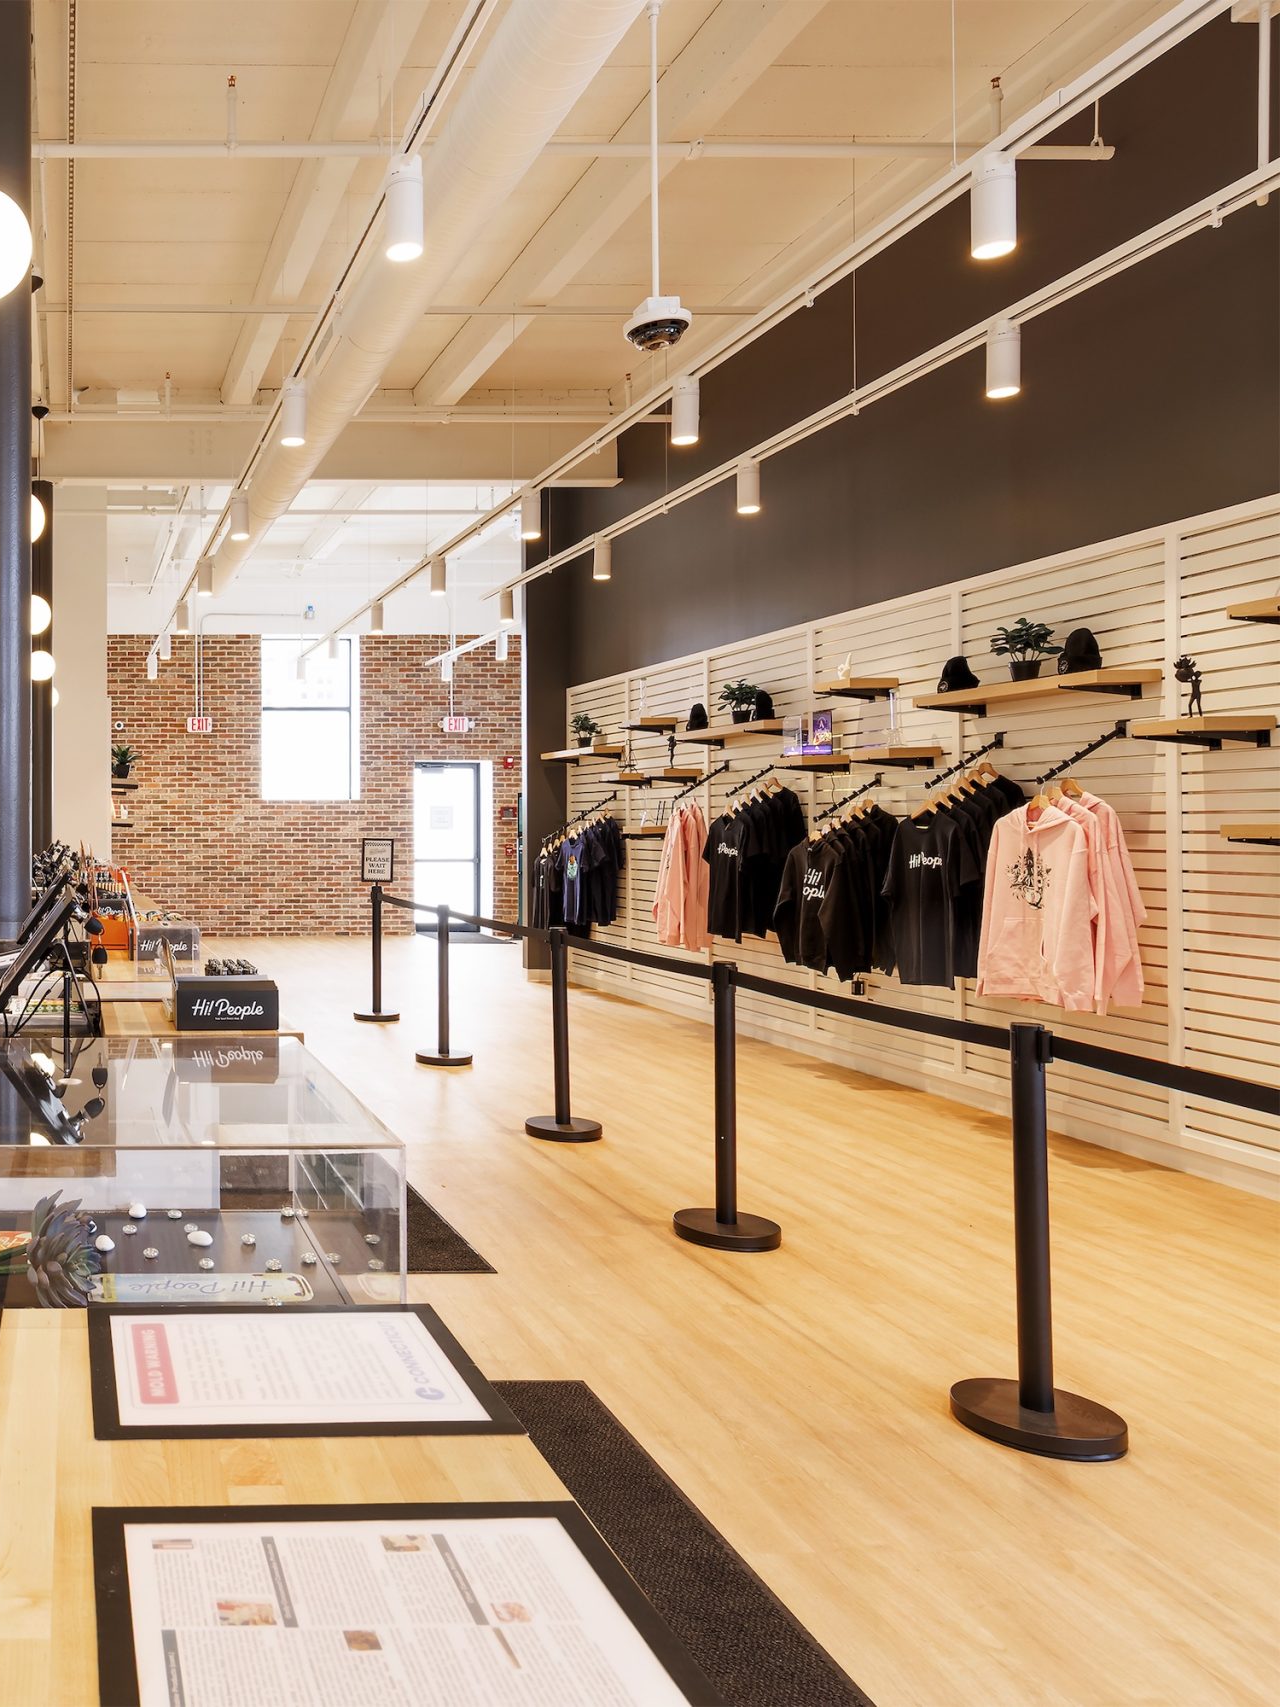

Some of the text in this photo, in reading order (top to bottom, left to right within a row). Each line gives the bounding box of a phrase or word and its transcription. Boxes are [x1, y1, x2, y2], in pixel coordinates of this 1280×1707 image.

[191, 718, 208, 731] EXIT
[448, 718, 465, 731] EXIT
[909, 853, 921, 869] Hi!
[804, 868, 822, 885] Hi!
[140, 940, 155, 951] Hi!
[192, 999, 264, 1020] Hi! People
[377, 1320, 430, 1385] CONNECTICUT
[141, 1329, 167, 1397] MOLD WARNING
